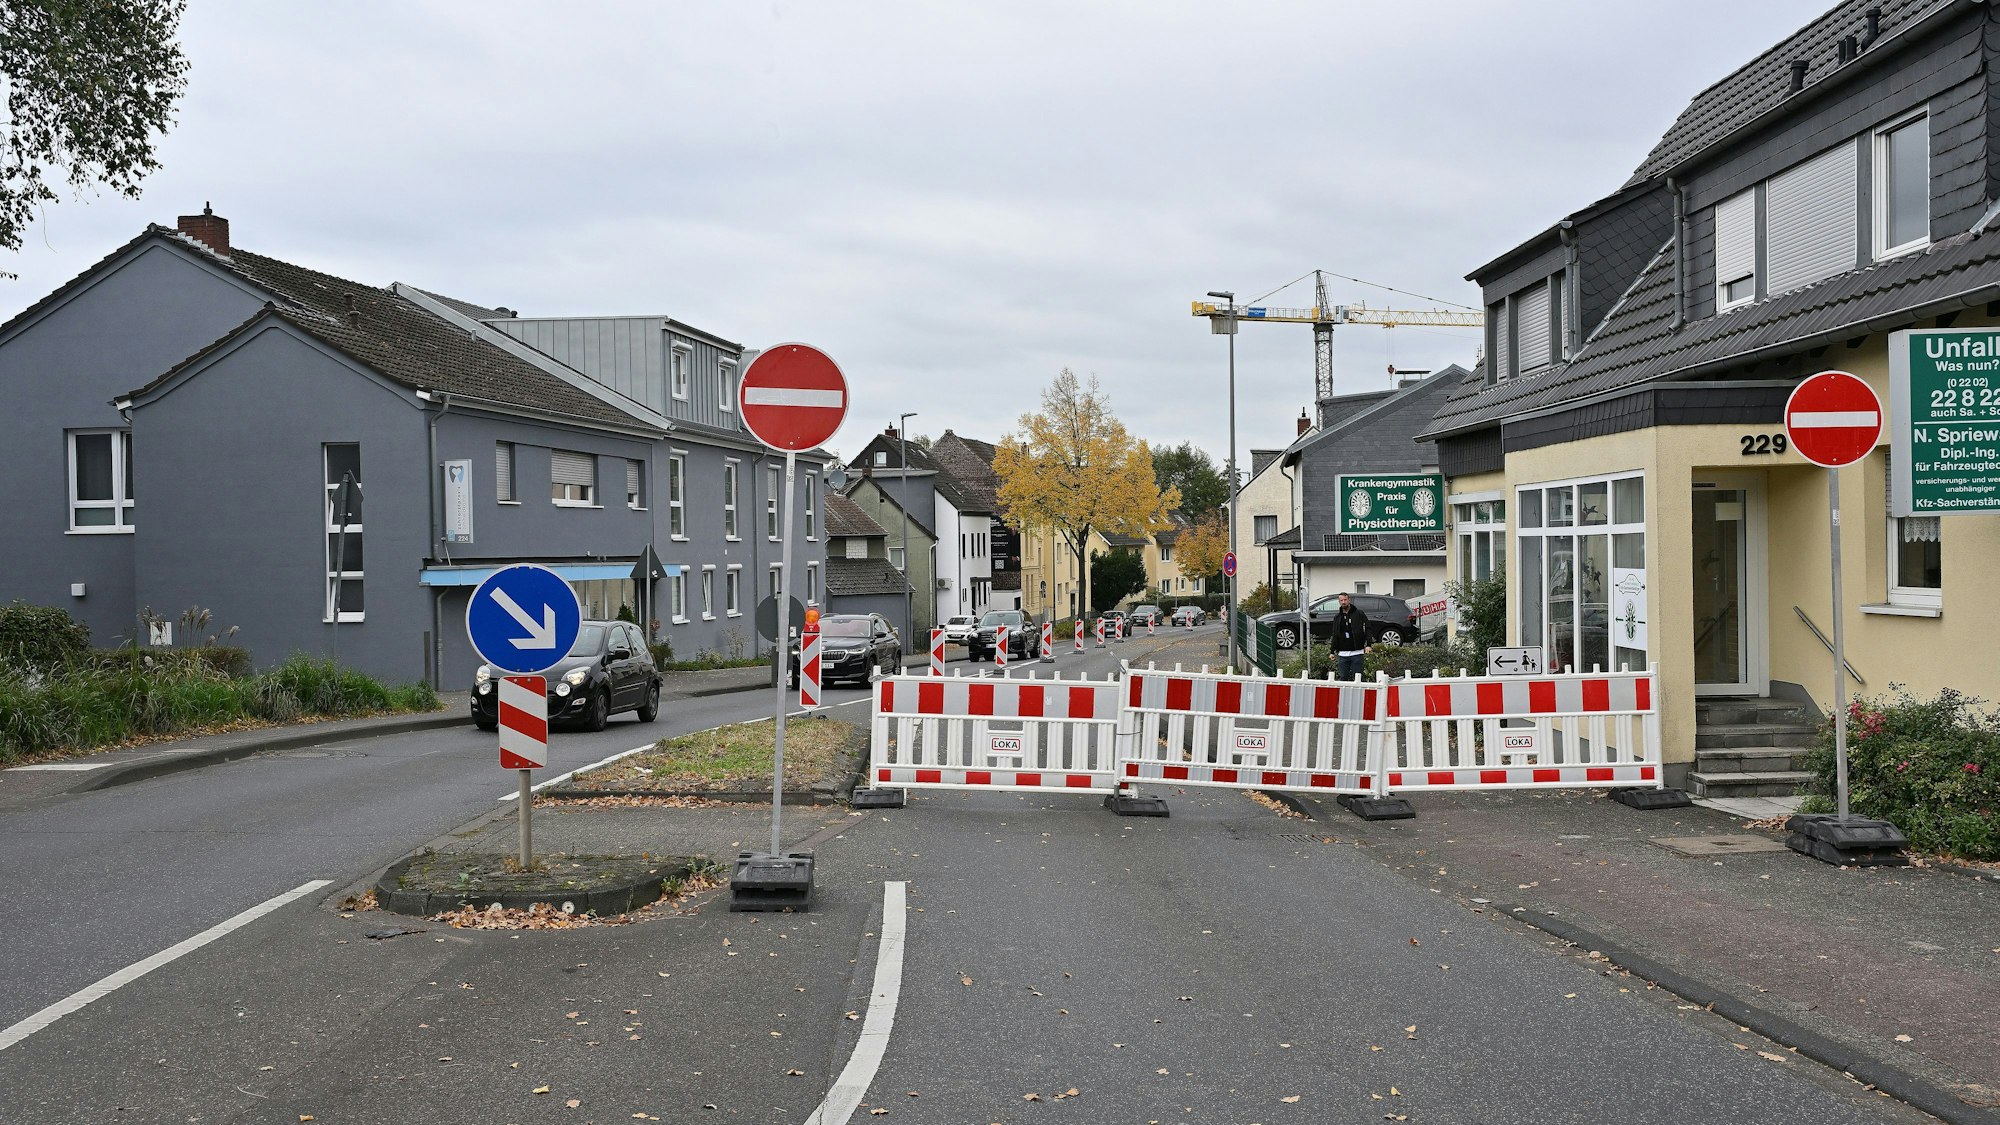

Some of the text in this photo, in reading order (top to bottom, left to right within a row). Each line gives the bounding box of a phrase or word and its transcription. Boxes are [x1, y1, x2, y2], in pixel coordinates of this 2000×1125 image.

[1926, 336, 2000, 358] Unfall
[1935, 359, 2000, 372] Was nun?
[1947, 377, 1989, 389] (0 22 02)
[1931, 389, 1957, 407] 22
[1961, 389, 1975, 407] 8
[1930, 408, 1956, 417] auch
[1959, 407, 1976, 417] Sa.
[1914, 427, 2000, 446] N. Spriew
[1740, 433, 1787, 456] 229
[1940, 446, 1999, 460] Dipl.-Ing.
[1915, 462, 1931, 471] für
[1347, 478, 1435, 488] Krankengymnastik
[1915, 477, 1970, 485] versicherungs-
[1945, 485, 1996, 494] unabhängiger
[1377, 492, 1406, 501] Praxis
[1916, 497, 2000, 508] Kfz-Sachverstän
[1385, 505, 1399, 514] für
[1348, 517, 1436, 530] Physiotherapie
